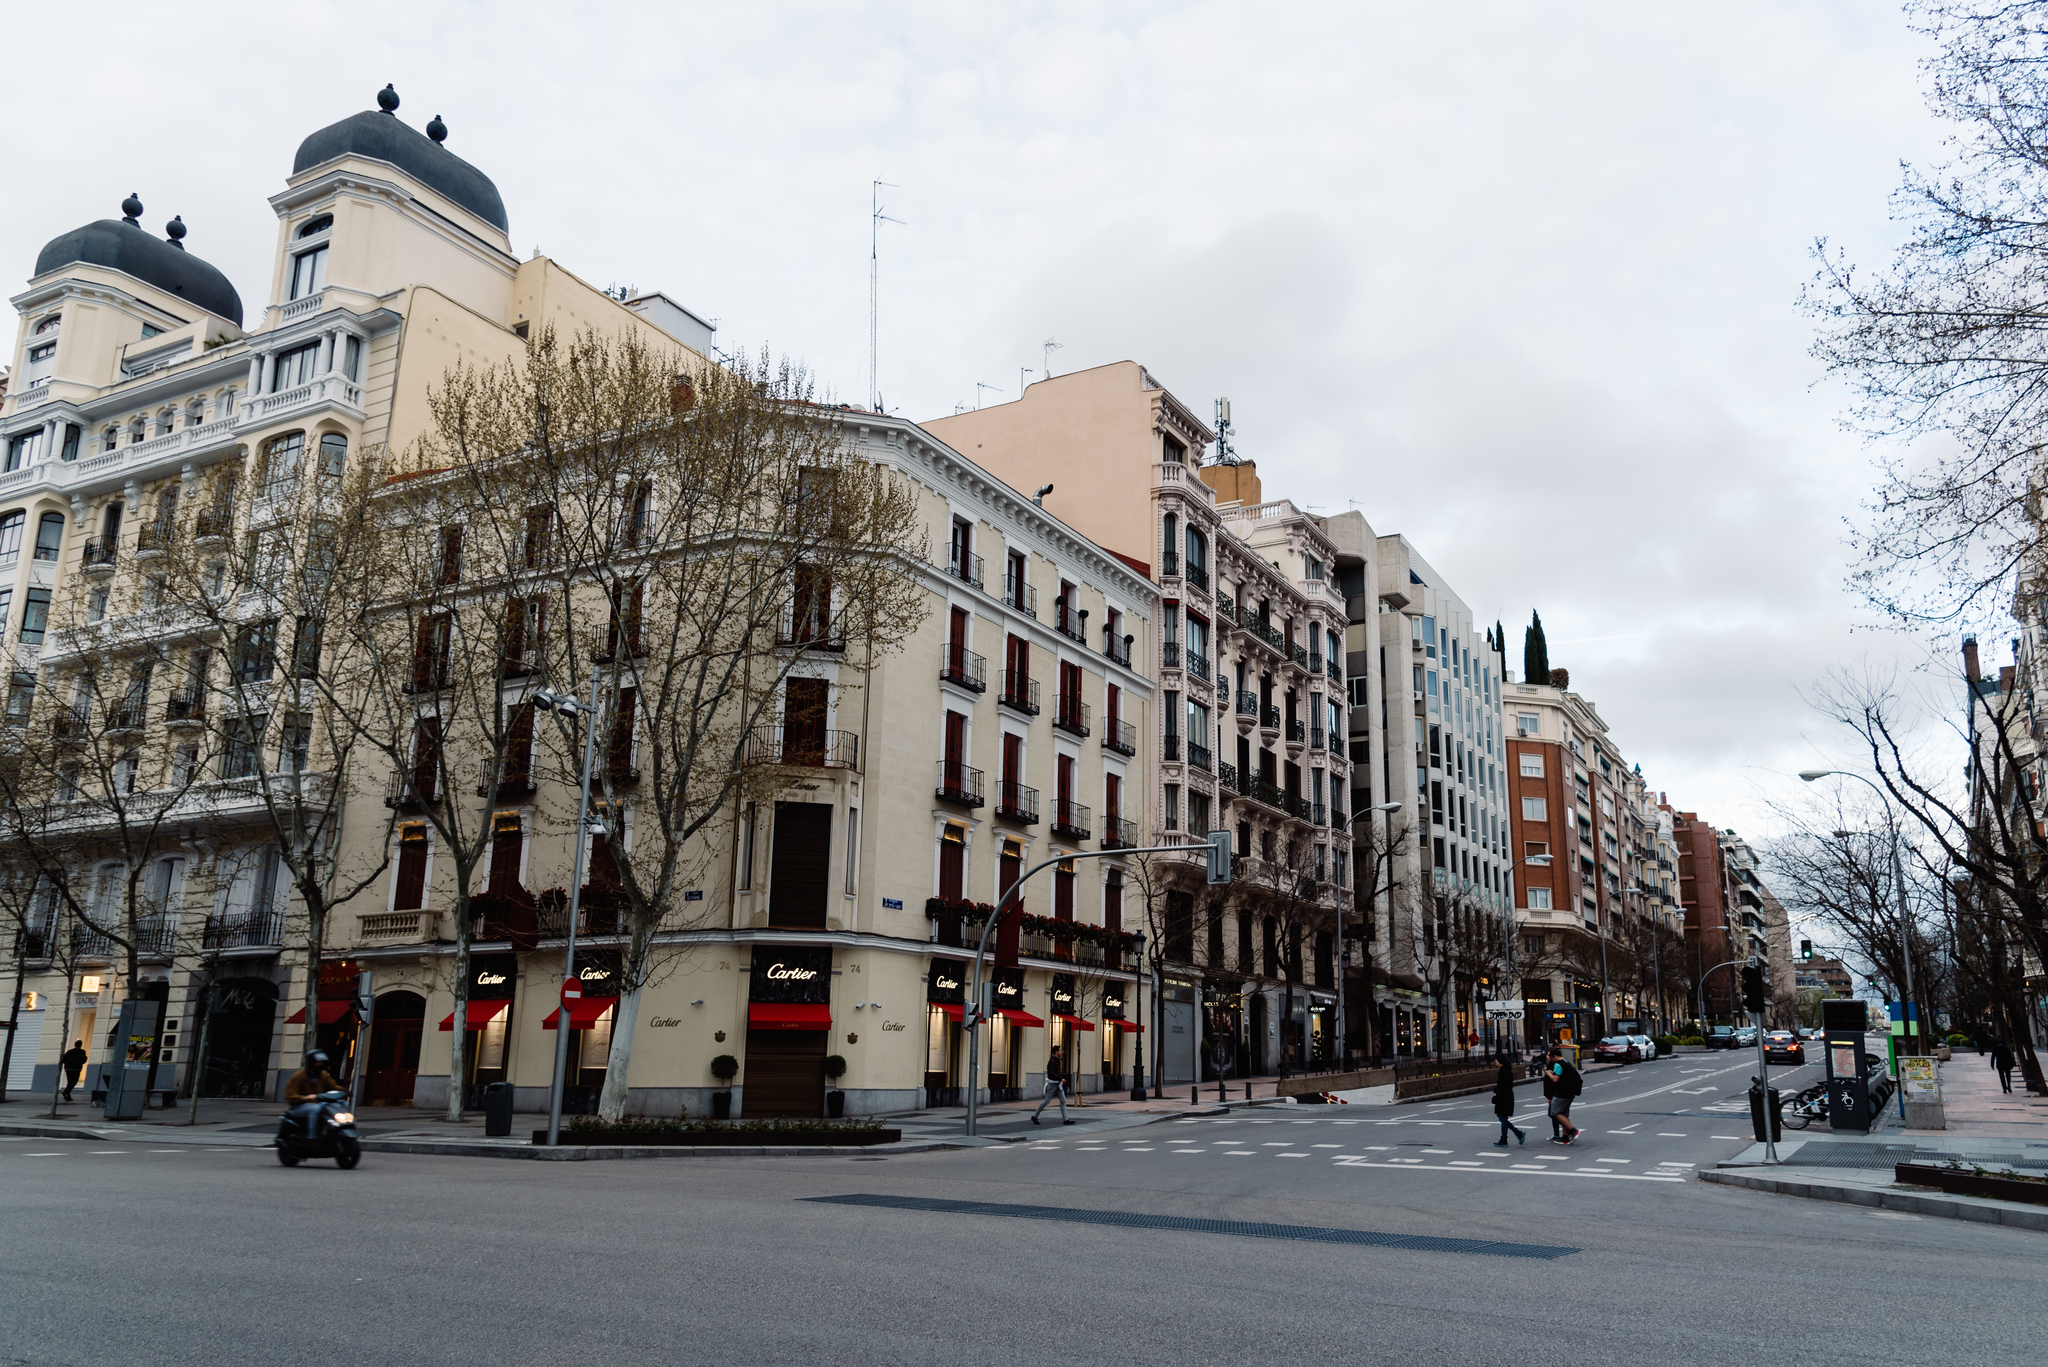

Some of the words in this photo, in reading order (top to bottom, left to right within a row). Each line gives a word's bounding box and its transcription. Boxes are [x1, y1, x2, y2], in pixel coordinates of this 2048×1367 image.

[720, 962, 730, 970] 74
[767, 963, 817, 980] Cartier
[850, 964, 861, 973] 74
[478, 972, 506, 985] Cartier
[580, 967, 610, 980] Cartier
[937, 975, 958, 989] Cartier
[998, 982, 1017, 995] Cartier
[1054, 989, 1072, 1002] Cartier
[1105, 995, 1121, 1007] Cartier
[650, 1016, 681, 1027] Cartier
[882, 1020, 906, 1031] Cartier
